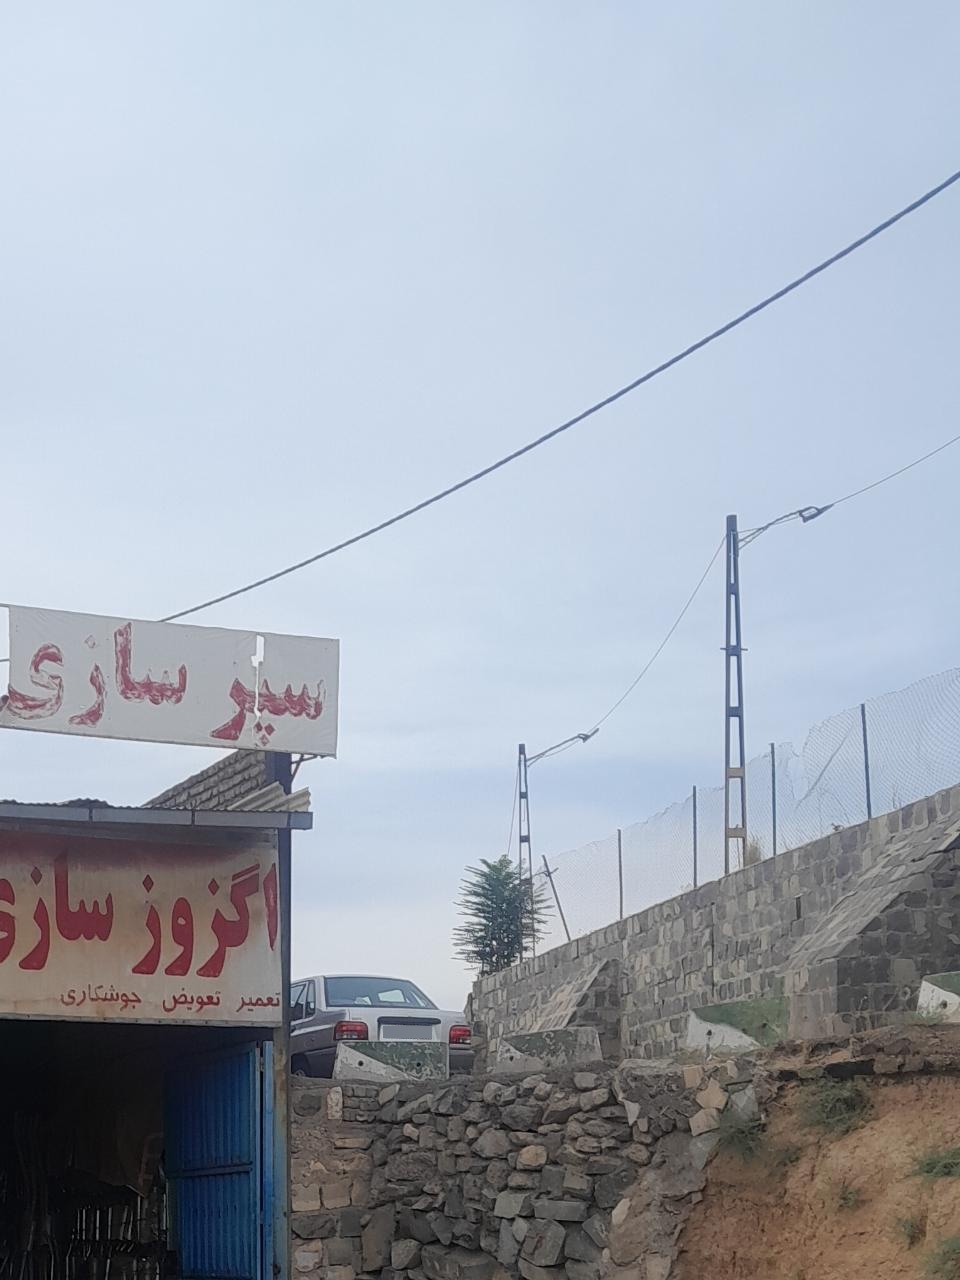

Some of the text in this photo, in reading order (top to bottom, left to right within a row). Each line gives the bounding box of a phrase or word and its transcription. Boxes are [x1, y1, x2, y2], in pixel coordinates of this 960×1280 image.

[6, 622, 188, 728] سازی
[132, 861, 278, 978] اگزوز
[60, 983, 281, 1013] تعمیر تعویض جوشکاری
